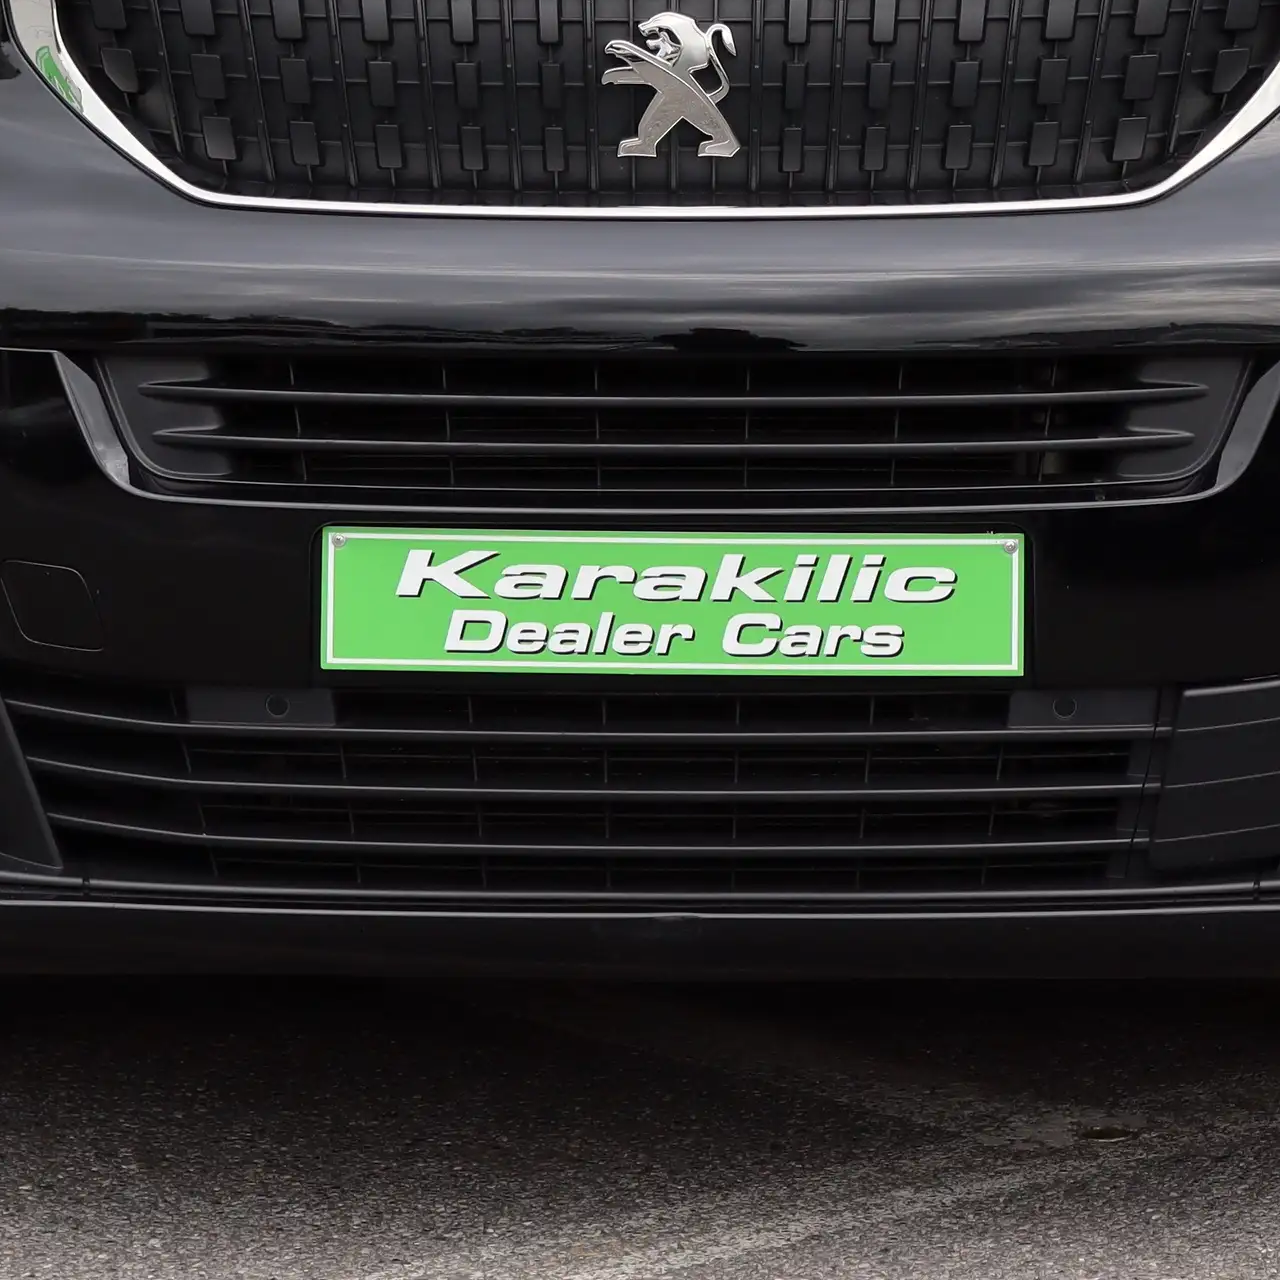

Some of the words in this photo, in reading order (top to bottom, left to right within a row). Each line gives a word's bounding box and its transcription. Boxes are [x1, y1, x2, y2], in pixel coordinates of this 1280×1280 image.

[395, 548, 958, 603] Karakilic
[443, 609, 696, 656] Dealer
[721, 612, 906, 658] Cars
